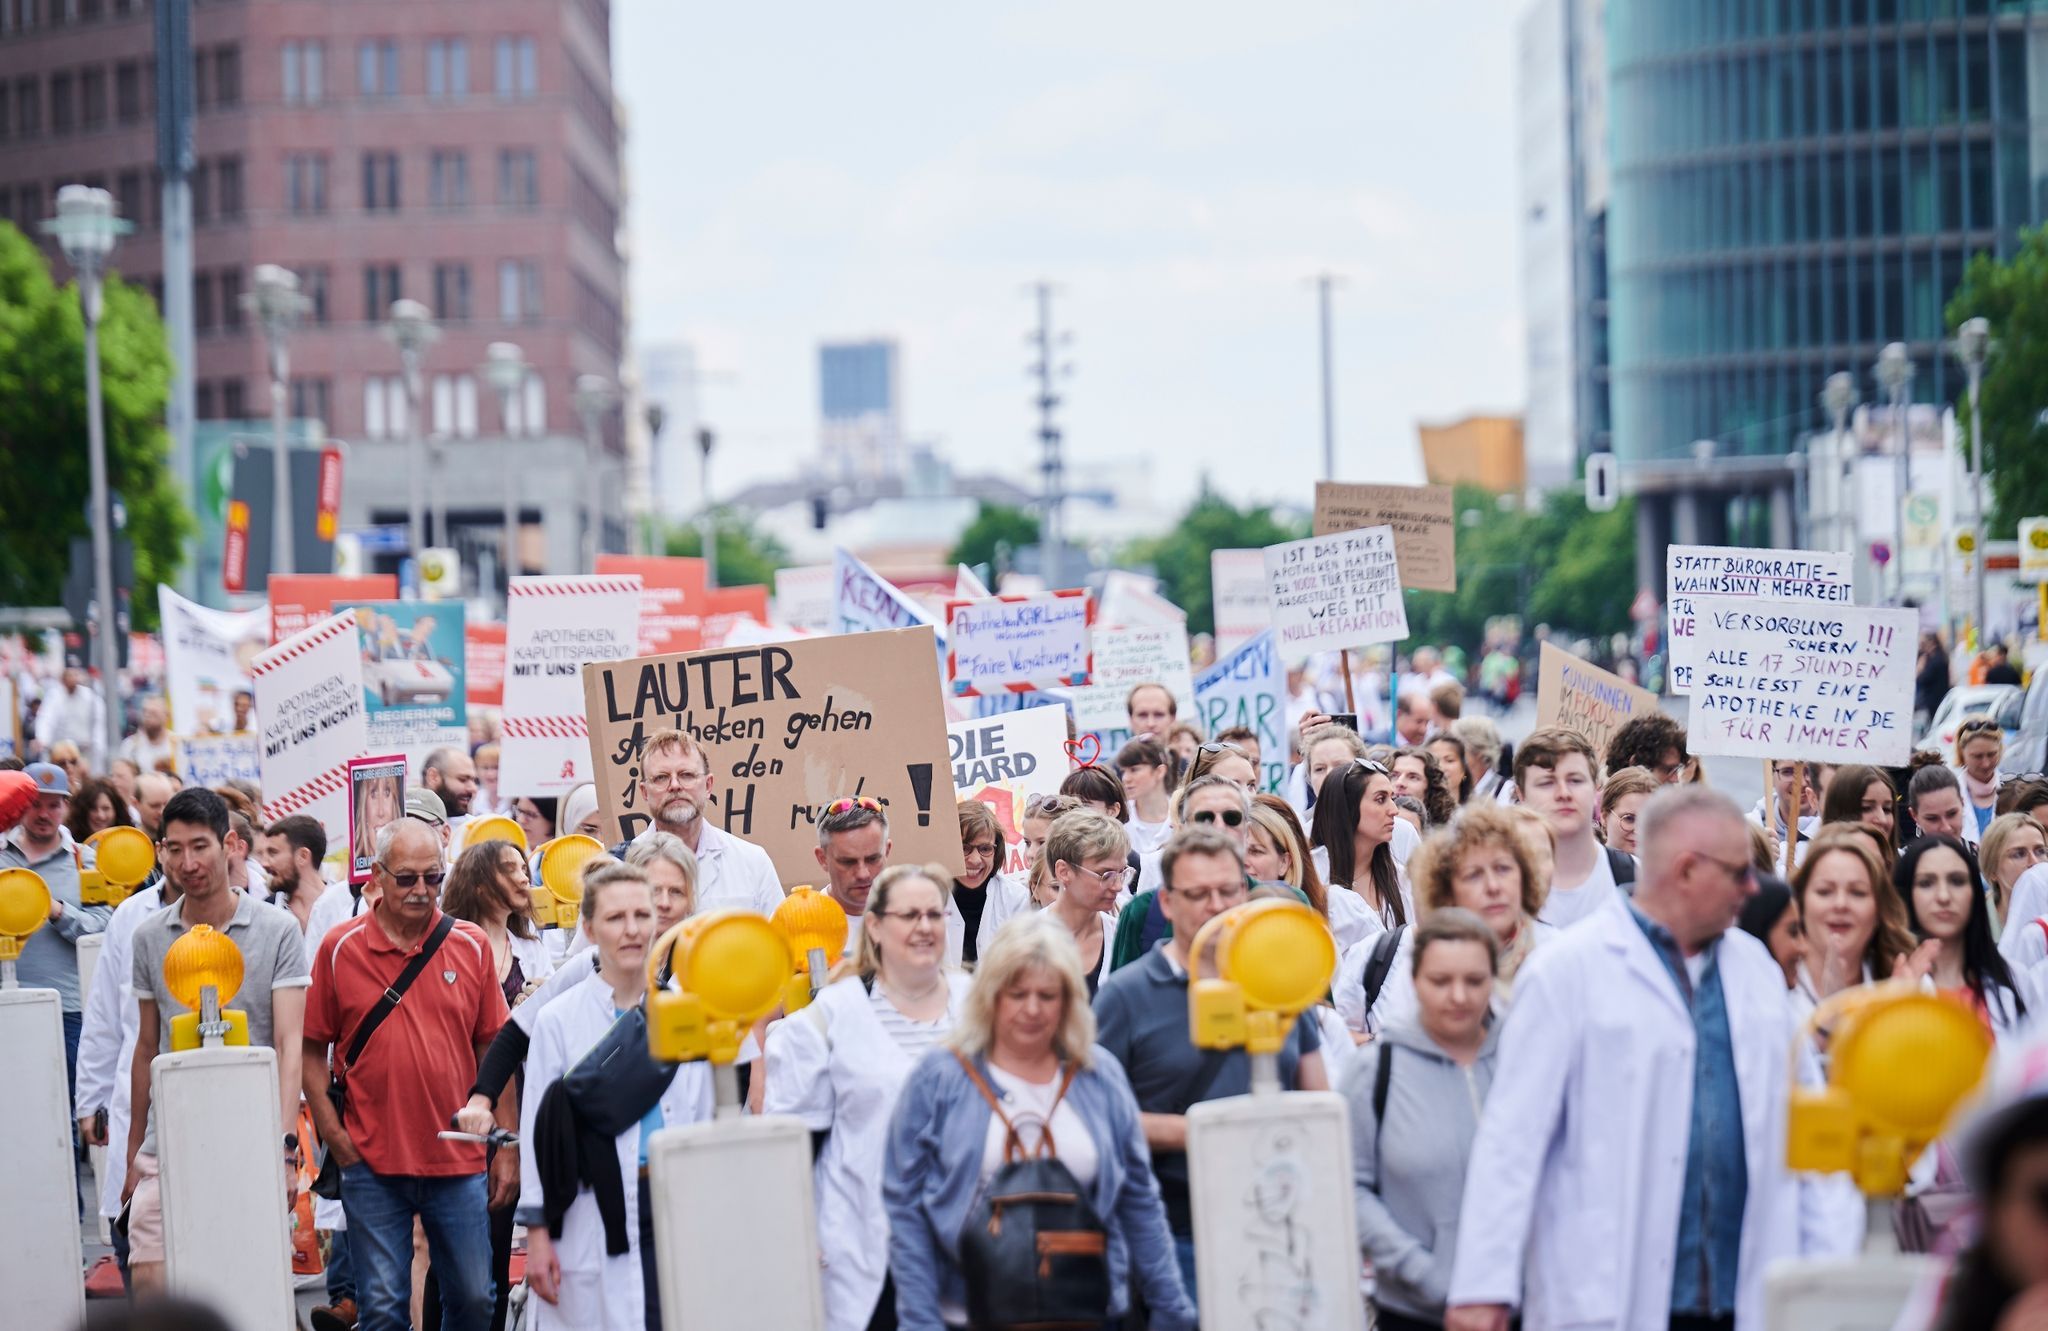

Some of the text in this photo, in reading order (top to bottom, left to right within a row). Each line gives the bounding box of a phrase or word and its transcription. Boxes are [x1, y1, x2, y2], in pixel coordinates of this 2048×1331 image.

[1283, 547, 1304, 563] IST
[1315, 542, 1339, 558] DAS
[1674, 556, 1721, 571] STATT
[1273, 560, 1339, 580] APOTHEKEN
[1277, 587, 1346, 608] AUSGESTELLTE
[1352, 578, 1398, 595] REZEPTE
[1308, 594, 1385, 618] WEG MIT
[1673, 598, 1695, 615] FÜ
[530, 629, 615, 642] APOTHEKEN
[1673, 618, 1695, 637] WE
[1714, 611, 1843, 637] VERSORGUNG
[513, 645, 630, 659] KAPUTTSPAREN?
[1785, 639, 1857, 654] SICHERN
[513, 664, 576, 675] MIT UNS
[970, 654, 1006, 676] Faire
[1706, 650, 1885, 679] ALLE 17 STUNDEN
[278, 673, 343, 715] APOTHEKEN
[603, 647, 801, 722] LAUTER
[1704, 674, 1870, 701] SCHLIESST EINE
[265, 683, 357, 739] KAPUTTSPAREN?
[373, 708, 455, 722] REGIERUNG
[783, 696, 872, 749] gehen
[1575, 692, 1617, 728] FOKUS
[1702, 694, 1895, 729] APOTHEKE IN DE
[267, 737, 287, 758] MIT
[291, 723, 316, 744] UNS
[320, 701, 359, 730] NICHT!
[948, 724, 1005, 761] DIE
[1721, 717, 1870, 750] FÜR IMMER
[731, 744, 783, 778] den
[953, 752, 1037, 789] HARD
